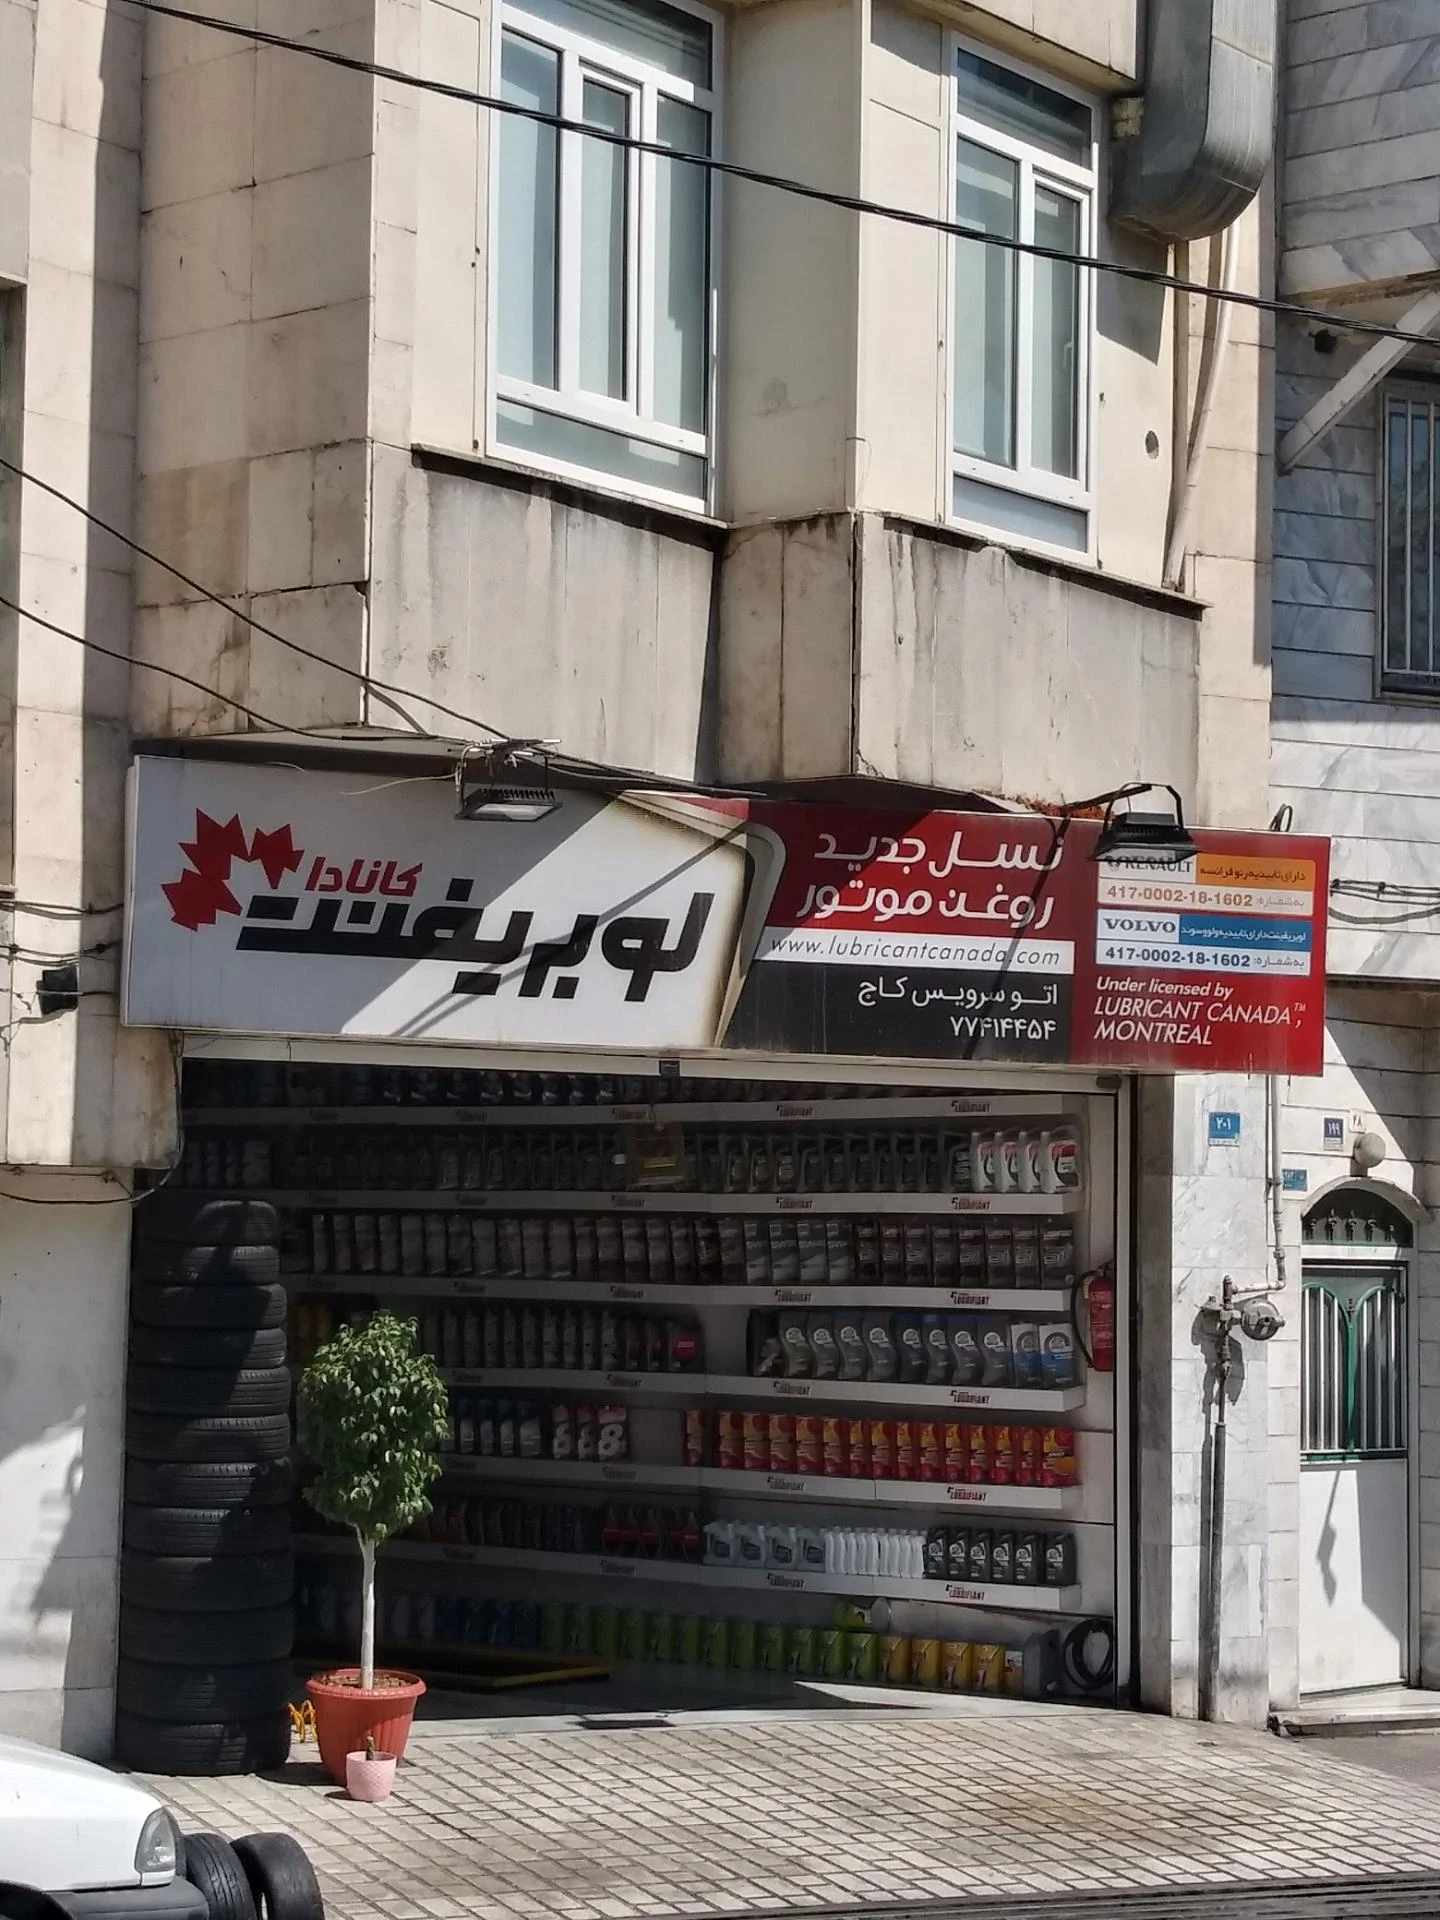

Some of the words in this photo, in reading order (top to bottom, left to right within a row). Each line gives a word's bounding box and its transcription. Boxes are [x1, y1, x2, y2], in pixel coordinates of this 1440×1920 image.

[814, 833, 927, 874] جدید
[928, 831, 1065, 878] نسل
[304, 856, 423, 897] کانادا
[796, 879, 933, 922] موتور
[938, 884, 1055, 930] روغن
[1107, 885, 1253, 907] 417-0002-18-1602
[1103, 918, 1176, 933] VOLVO
[771, 935, 1061, 966] www.lubricantcanada.com
[1105, 946, 1251, 968] 417-0002-18-1602
[857, 976, 909, 1006] کاج
[911, 985, 1005, 1010] سرویس
[1010, 983, 1057, 1011] اتو
[1096, 976, 1146, 992] Under
[1148, 978, 1213, 997] licensed
[1214, 981, 1234, 1000] by
[1094, 996, 1203, 1021] LUBRICANT
[950, 1016, 1056, 1040] ۷۷۴۱۴۴۵۴
[1093, 1020, 1213, 1045] MONTREAL
[1216, 1116, 1231, 1130] ۲۰۱
